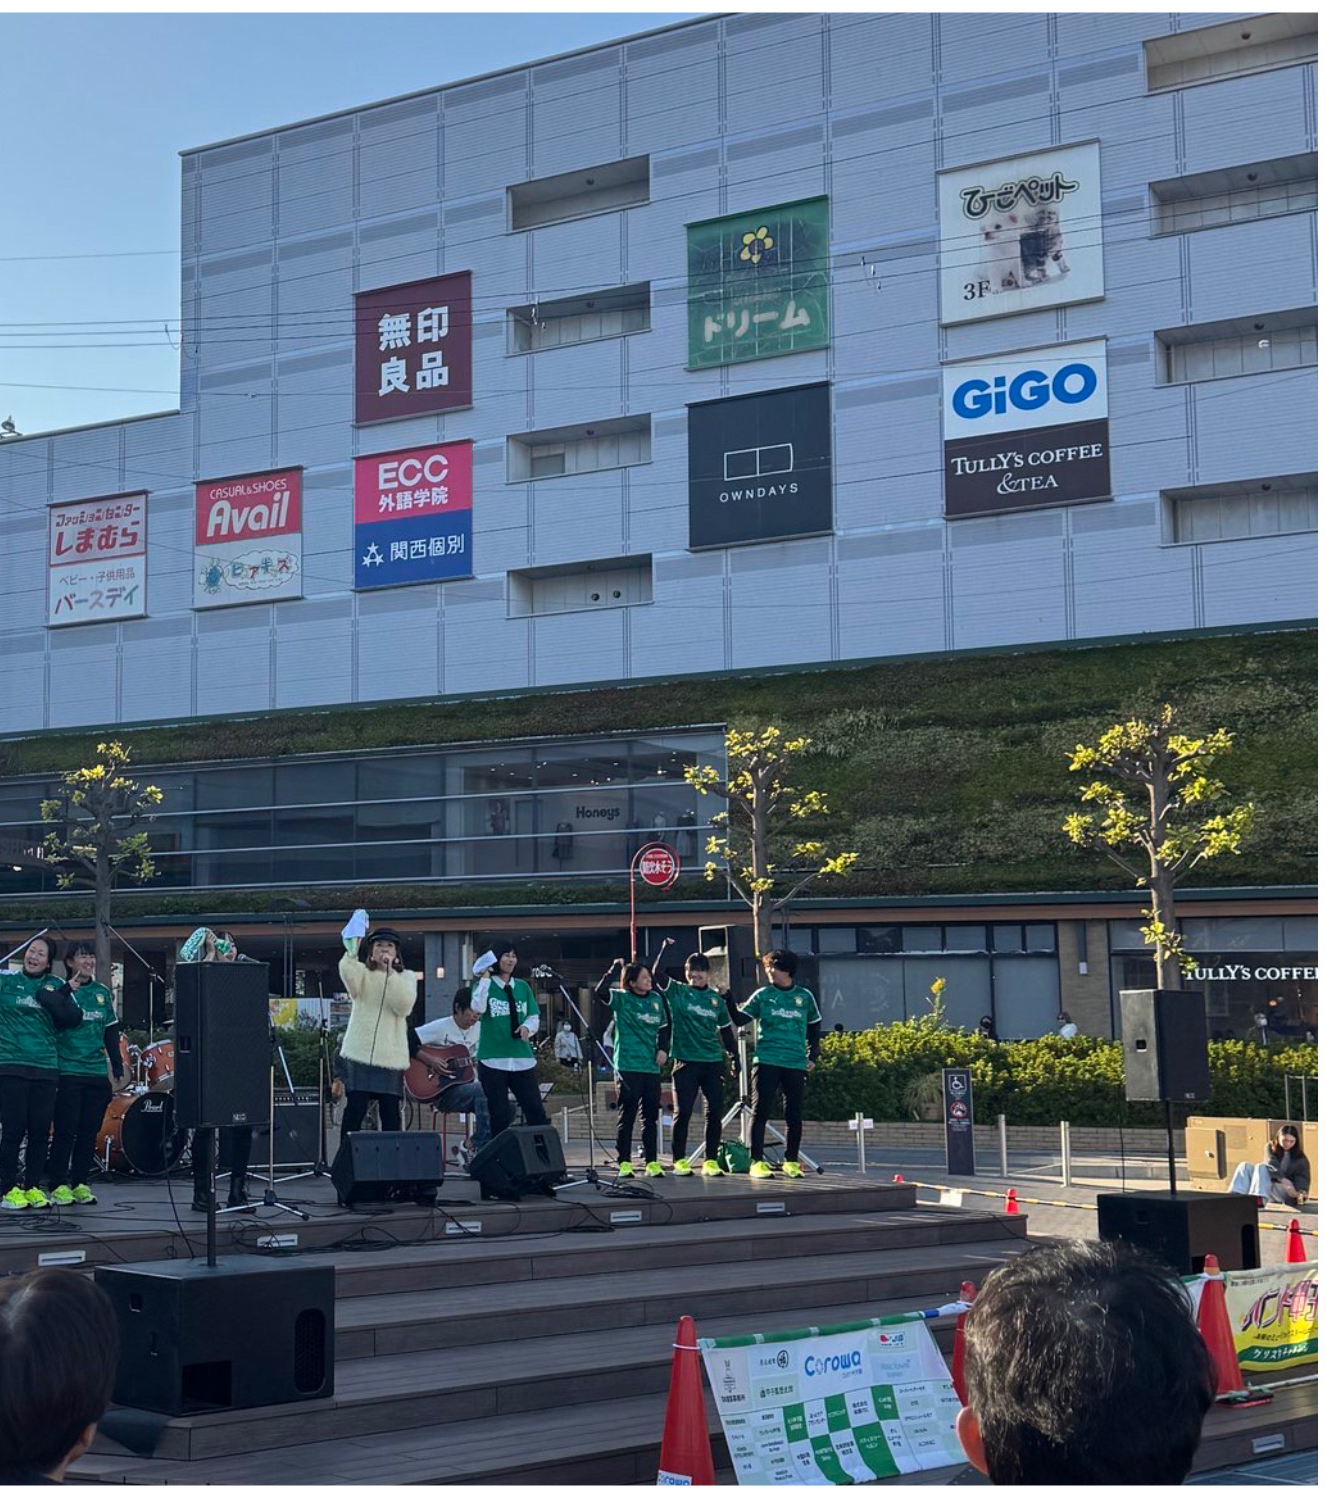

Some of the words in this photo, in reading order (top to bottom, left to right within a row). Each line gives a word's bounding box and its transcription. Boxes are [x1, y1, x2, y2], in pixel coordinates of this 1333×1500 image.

[963, 279, 990, 301] 3F
[704, 300, 811, 343] ドリーム
[951, 362, 1098, 420] GiGO
[378, 454, 449, 491] ECC
[950, 451, 1025, 476] TULLY'S
[1027, 443, 1104, 467] COFFEE
[378, 485, 449, 514] 外語学院
[719, 482, 800, 503] OWNDAYS
[55, 504, 141, 529] ファッションセンター
[206, 489, 290, 538] Avail
[54, 523, 139, 556] しまむら
[389, 533, 465, 563] 関西個別
[58, 567, 136, 587] ベビー・子供用品
[54, 584, 137, 615] バースデイ
[575, 804, 621, 821] Honeys
[1254, 966, 1318, 981] COFFE
[804, 1350, 861, 1377] Corowa
